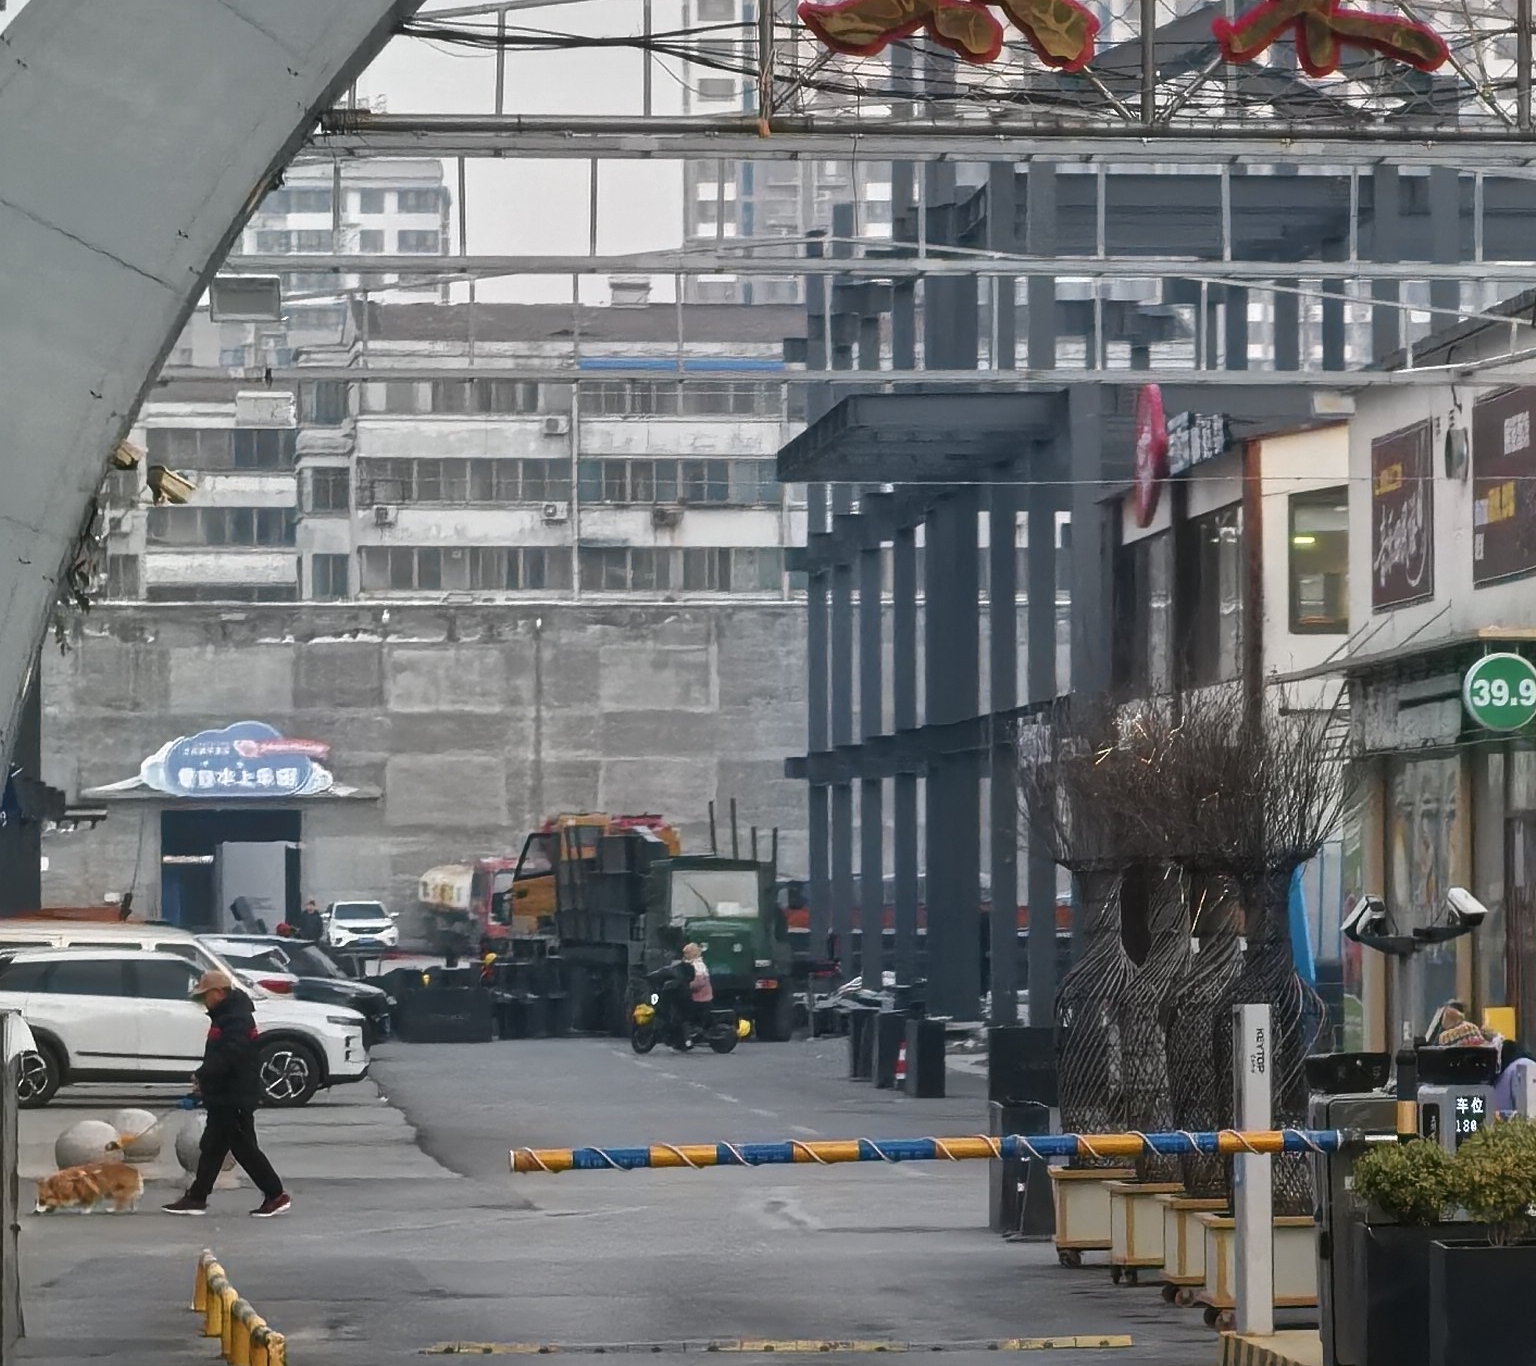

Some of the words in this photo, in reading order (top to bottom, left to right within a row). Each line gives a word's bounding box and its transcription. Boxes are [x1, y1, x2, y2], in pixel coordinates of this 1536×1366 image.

[1472, 678, 1536, 707] 39.9
[1256, 1028, 1265, 1074] KEYTOP
[1456, 1096, 1484, 1114] 车位
